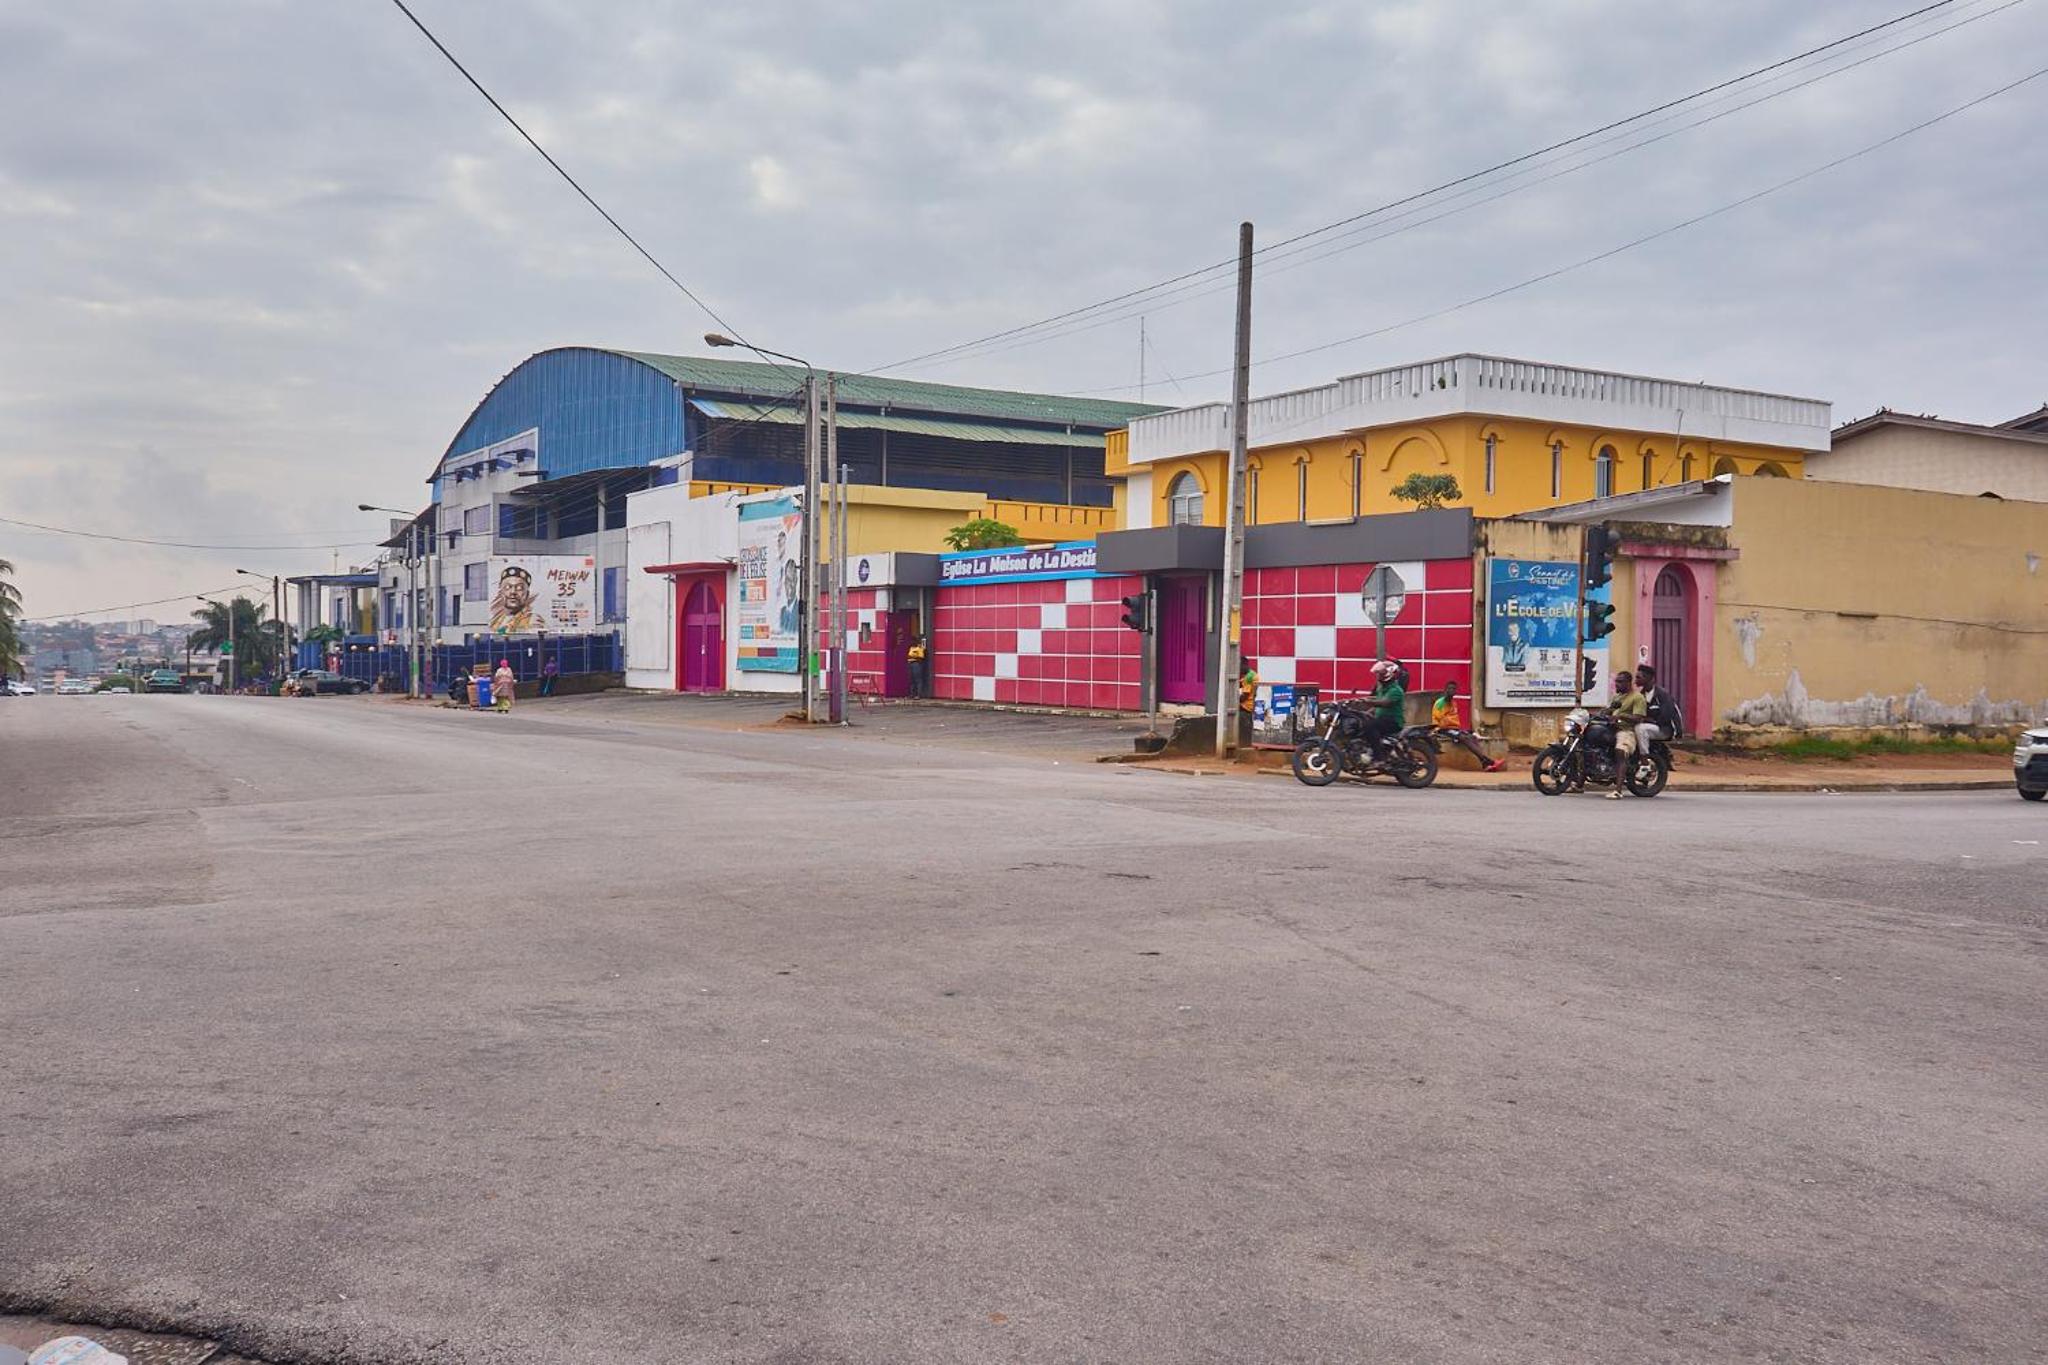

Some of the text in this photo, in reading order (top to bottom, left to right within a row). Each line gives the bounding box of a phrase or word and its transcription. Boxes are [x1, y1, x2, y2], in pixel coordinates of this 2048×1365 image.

[973, 559, 986, 574] La
[990, 555, 1028, 573] Maison
[1029, 553, 1042, 570] de
[1044, 552, 1059, 569] La
[547, 569, 590, 582] MEIWAY
[558, 582, 576, 597] 35
